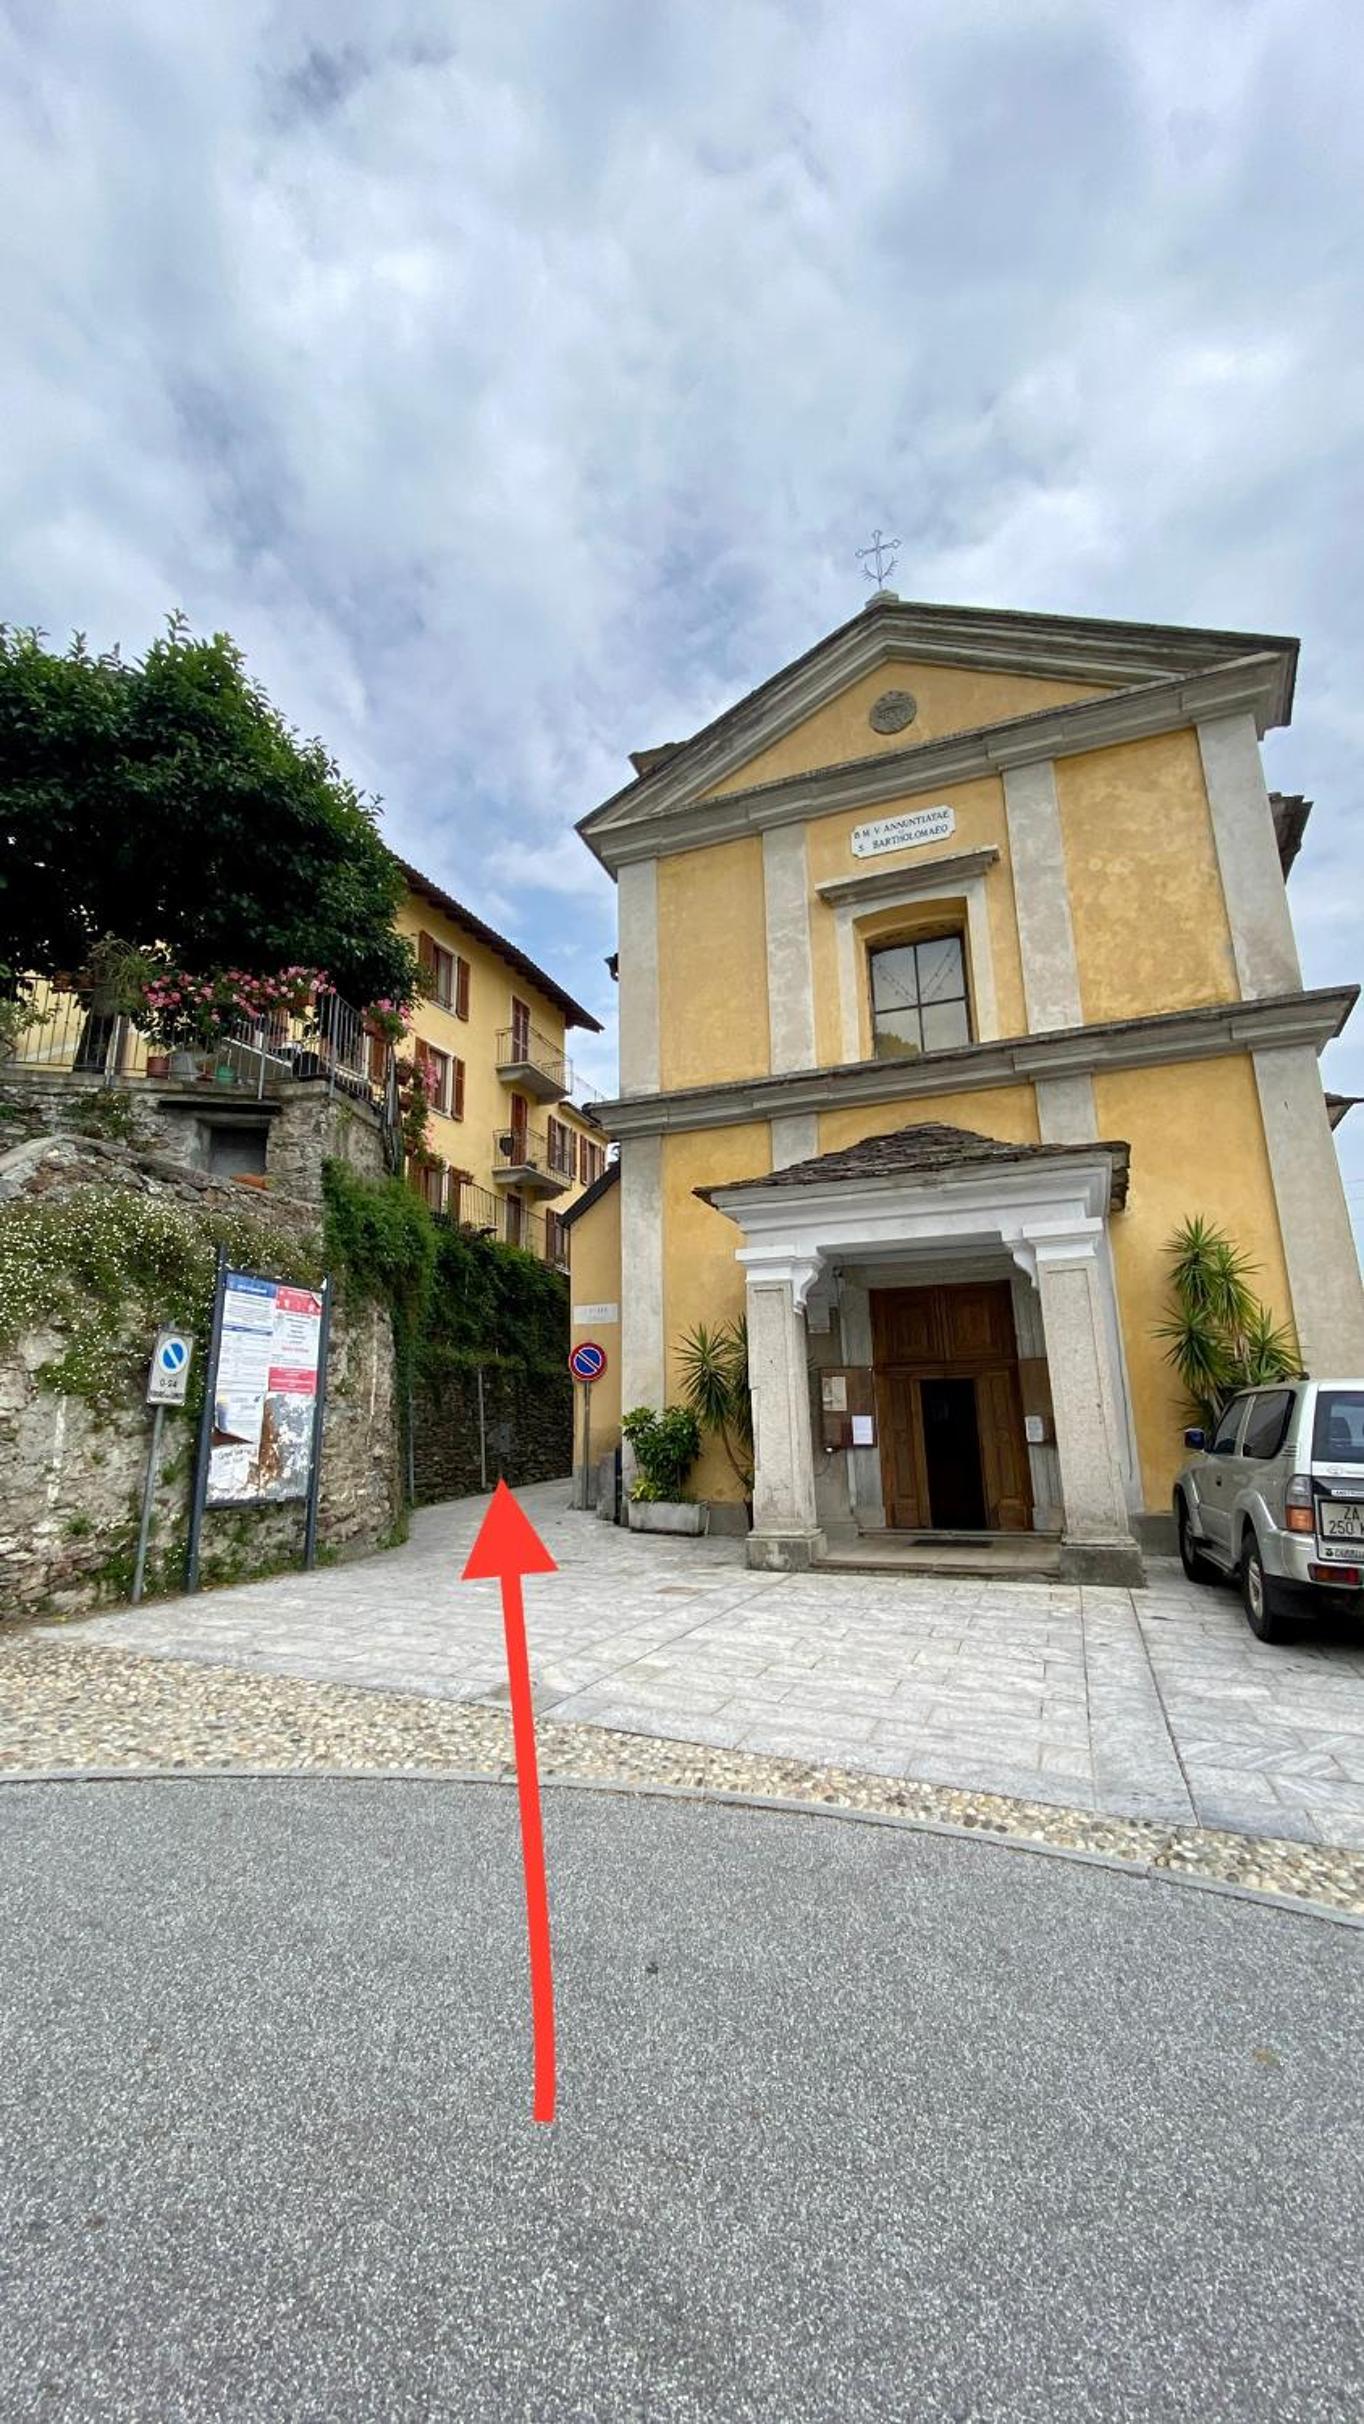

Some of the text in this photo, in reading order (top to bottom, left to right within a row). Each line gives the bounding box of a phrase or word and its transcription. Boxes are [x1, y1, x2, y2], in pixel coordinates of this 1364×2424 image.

[884, 810, 950, 833] ANNUNTIATAE
[872, 824, 948, 850] BARTHOLOMAEO
[1343, 1505, 1360, 1521] ZA
[1329, 1520, 1354, 1535] 250
